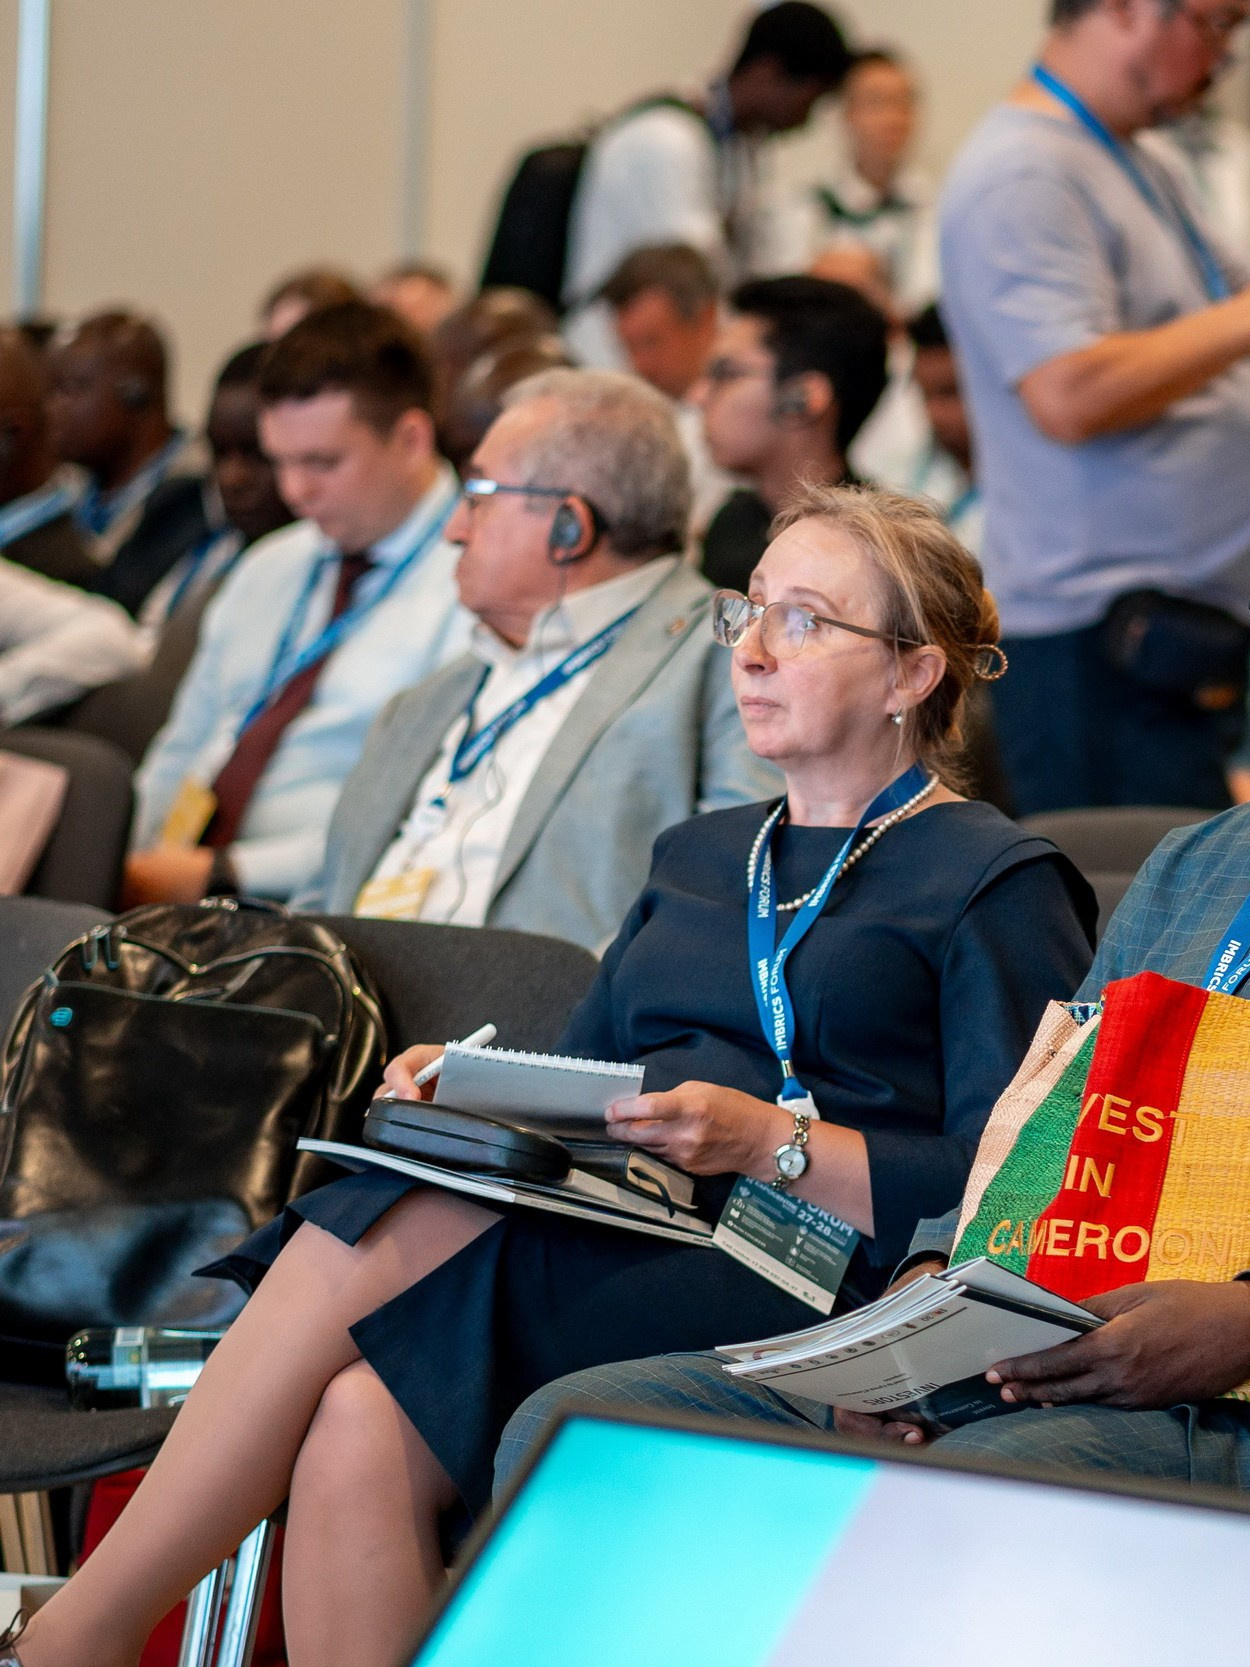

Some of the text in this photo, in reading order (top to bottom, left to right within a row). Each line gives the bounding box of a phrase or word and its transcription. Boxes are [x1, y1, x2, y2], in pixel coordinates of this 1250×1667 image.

[757, 883, 771, 918] FORUM
[757, 958, 769, 1007] IMBR
[1206, 939, 1242, 992] IMBRICS
[770, 947, 788, 1051] IMBRICS FORUM
[1064, 1154, 1116, 1198] IN
[797, 1209, 832, 1236] 27-28
[799, 1200, 855, 1236] ORUM
[987, 1218, 1234, 1267] CAMEROON
[863, 1382, 941, 1405] INVESTORS
